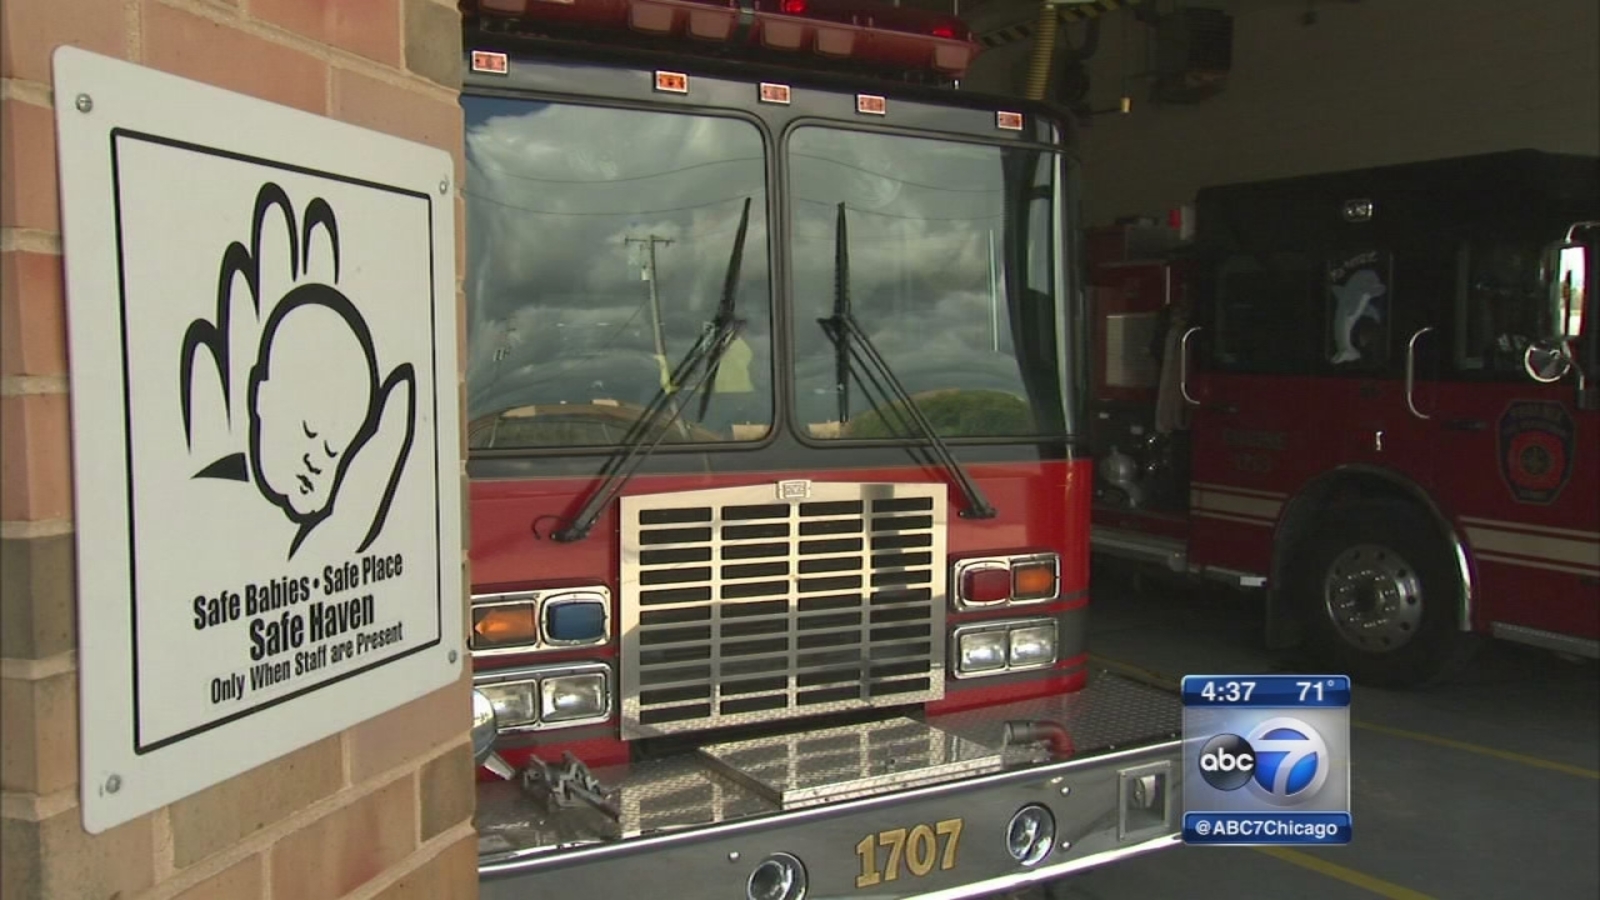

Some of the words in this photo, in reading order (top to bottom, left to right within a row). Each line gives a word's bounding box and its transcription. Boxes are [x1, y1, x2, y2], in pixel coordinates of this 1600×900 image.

[194, 590, 240, 630] Safe
[245, 575, 310, 617] Babies
[323, 561, 359, 596] Safe
[362, 553, 403, 586] Place
[249, 611, 304, 661] Safe
[309, 594, 375, 643] Haven
[211, 672, 246, 704] Only
[249, 660, 291, 691] When
[294, 644, 326, 676] Staff
[331, 639, 353, 664] are
[356, 621, 403, 655] Present
[854, 818, 962, 889] 1707
